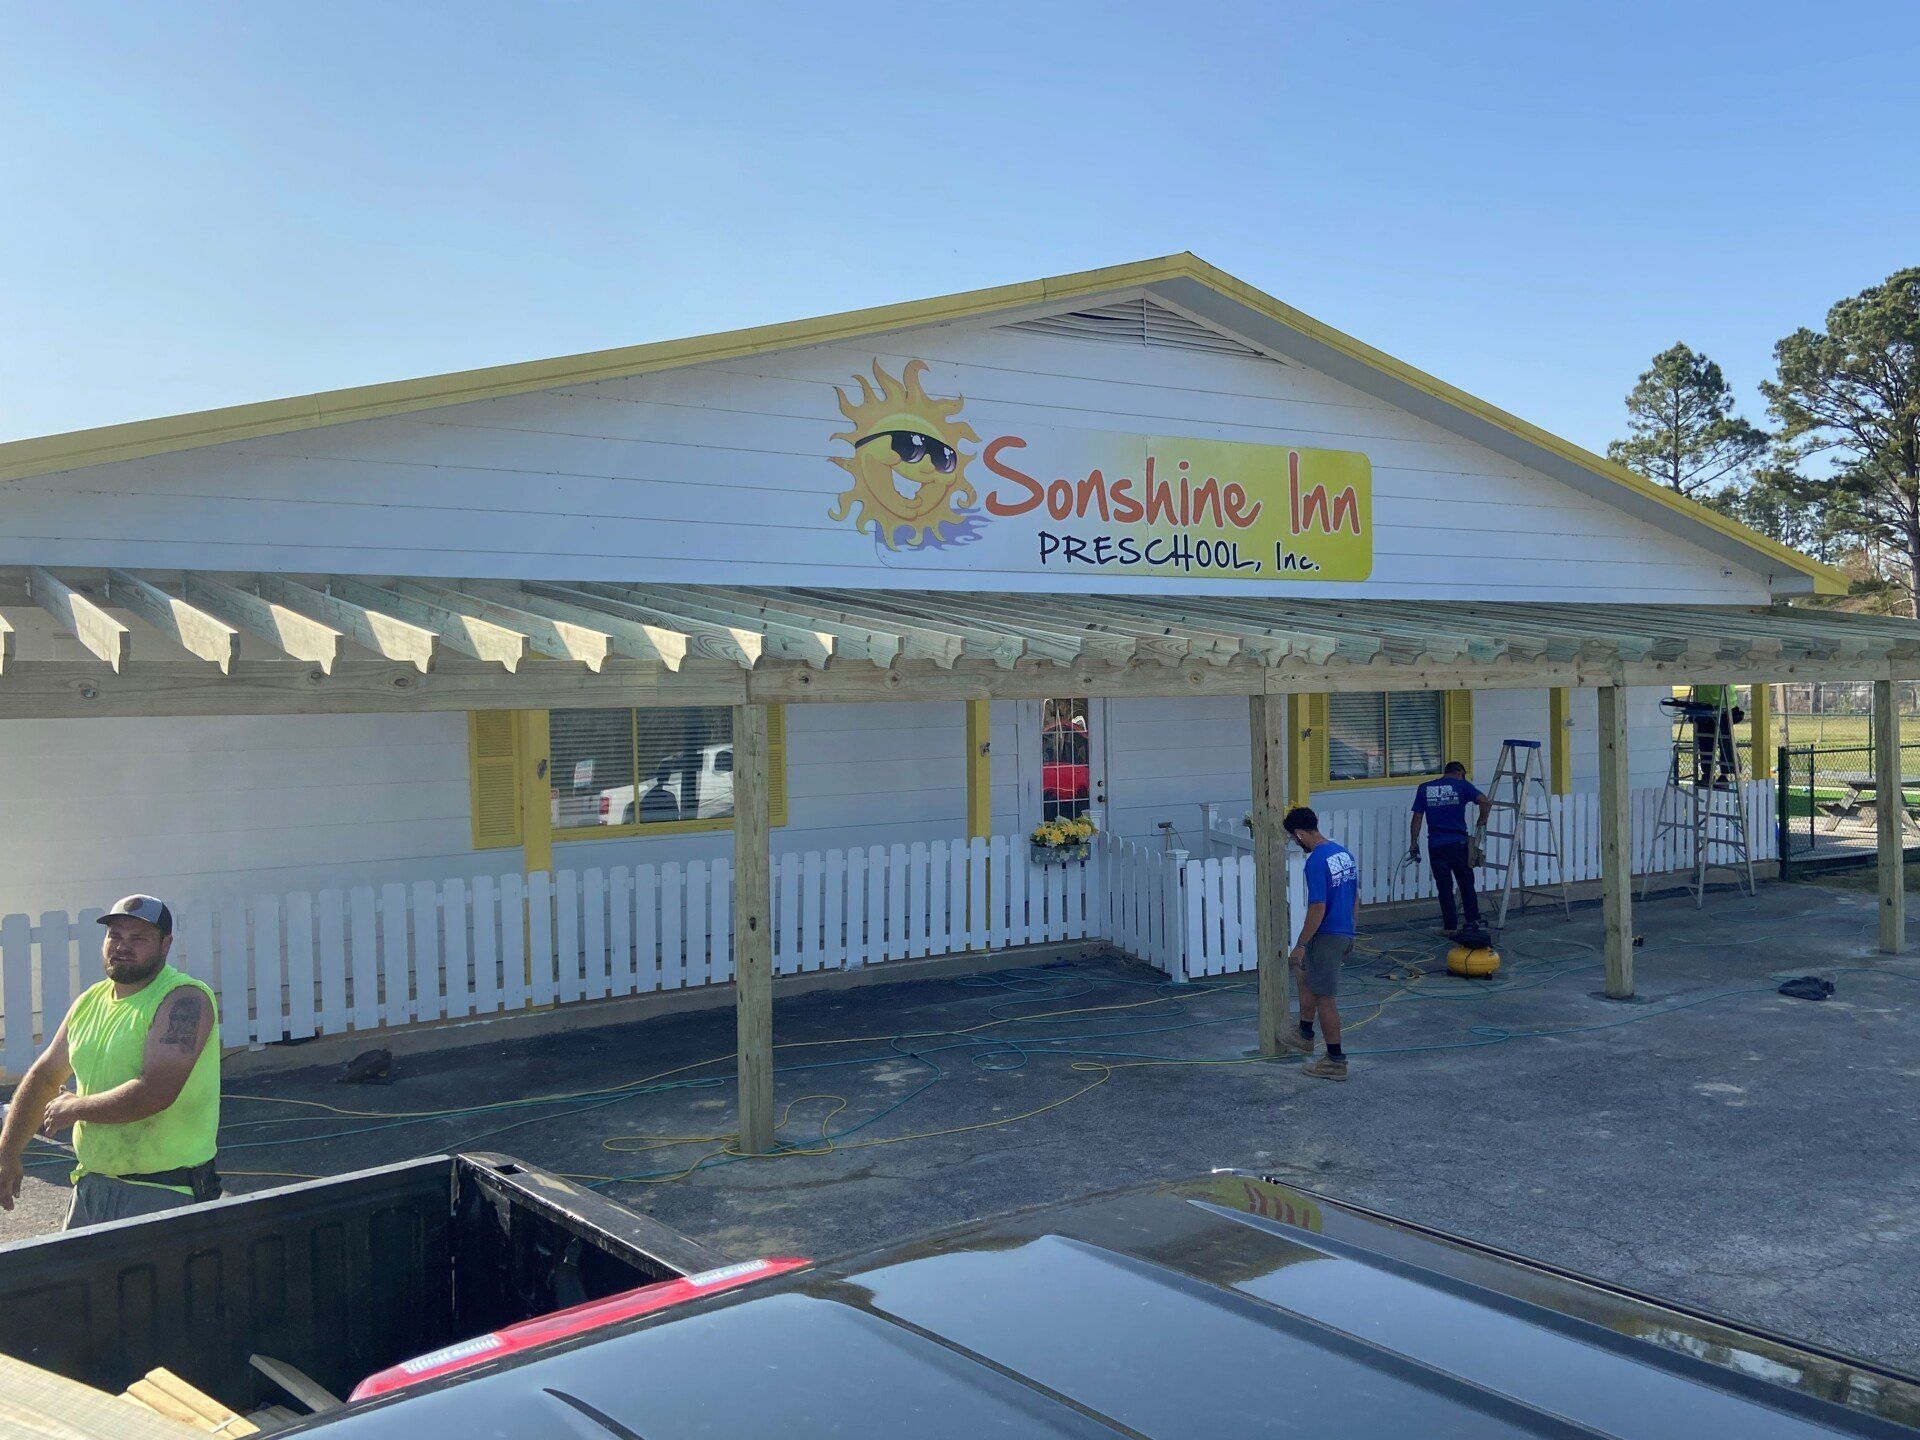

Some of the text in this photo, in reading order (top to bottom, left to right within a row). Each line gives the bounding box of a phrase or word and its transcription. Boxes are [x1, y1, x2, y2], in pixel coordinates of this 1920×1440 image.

[982, 435, 1362, 535] Sonshine Inn
[1037, 530, 1321, 573] PRESCHOOL, Inc.
